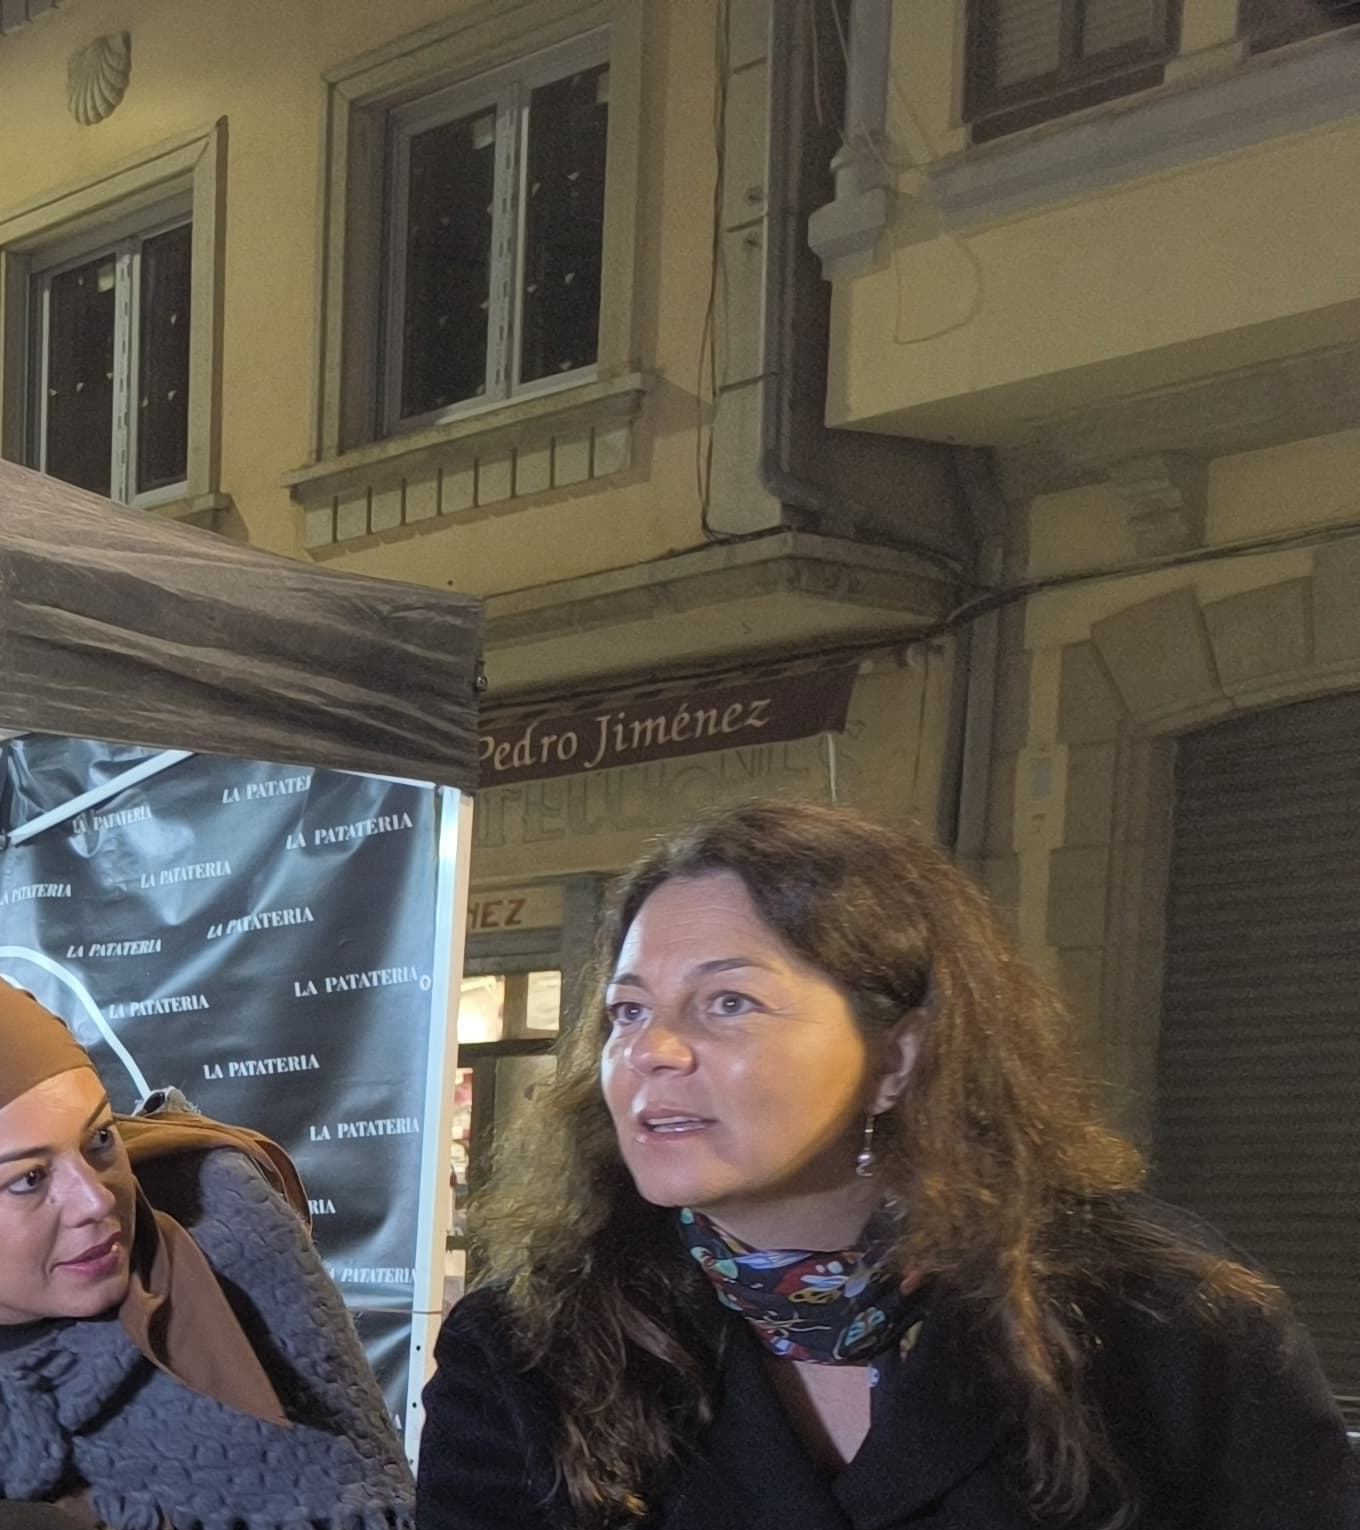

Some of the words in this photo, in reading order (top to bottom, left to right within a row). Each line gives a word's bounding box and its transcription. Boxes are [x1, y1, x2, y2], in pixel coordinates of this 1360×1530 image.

[480, 720, 579, 771] Pedro
[584, 698, 771, 768] Jiménez
[222, 789, 240, 803] LA
[72, 816, 86, 834] LA
[93, 805, 153, 832] PATATERIA
[286, 832, 306, 850] LA
[314, 812, 413, 845] PATATERIA
[141, 873, 157, 889] LA
[160, 860, 231, 884] PATATERIA
[12, 883, 72, 903] PATATERIA
[207, 923, 222, 939] LA
[226, 906, 314, 935] PATATERIA
[66, 945, 84, 958] LA
[89, 938, 162, 957] PATATERIA
[294, 981, 318, 998] LA
[325, 966, 418, 993] PATATERIA
[109, 1004, 125, 1019] LA
[129, 994, 210, 1016] PATATERIA
[204, 1064, 223, 1080] LA
[229, 1054, 320, 1078] PATATERIA
[310, 1126, 331, 1141] LA
[337, 1117, 419, 1140] PATATERIA
